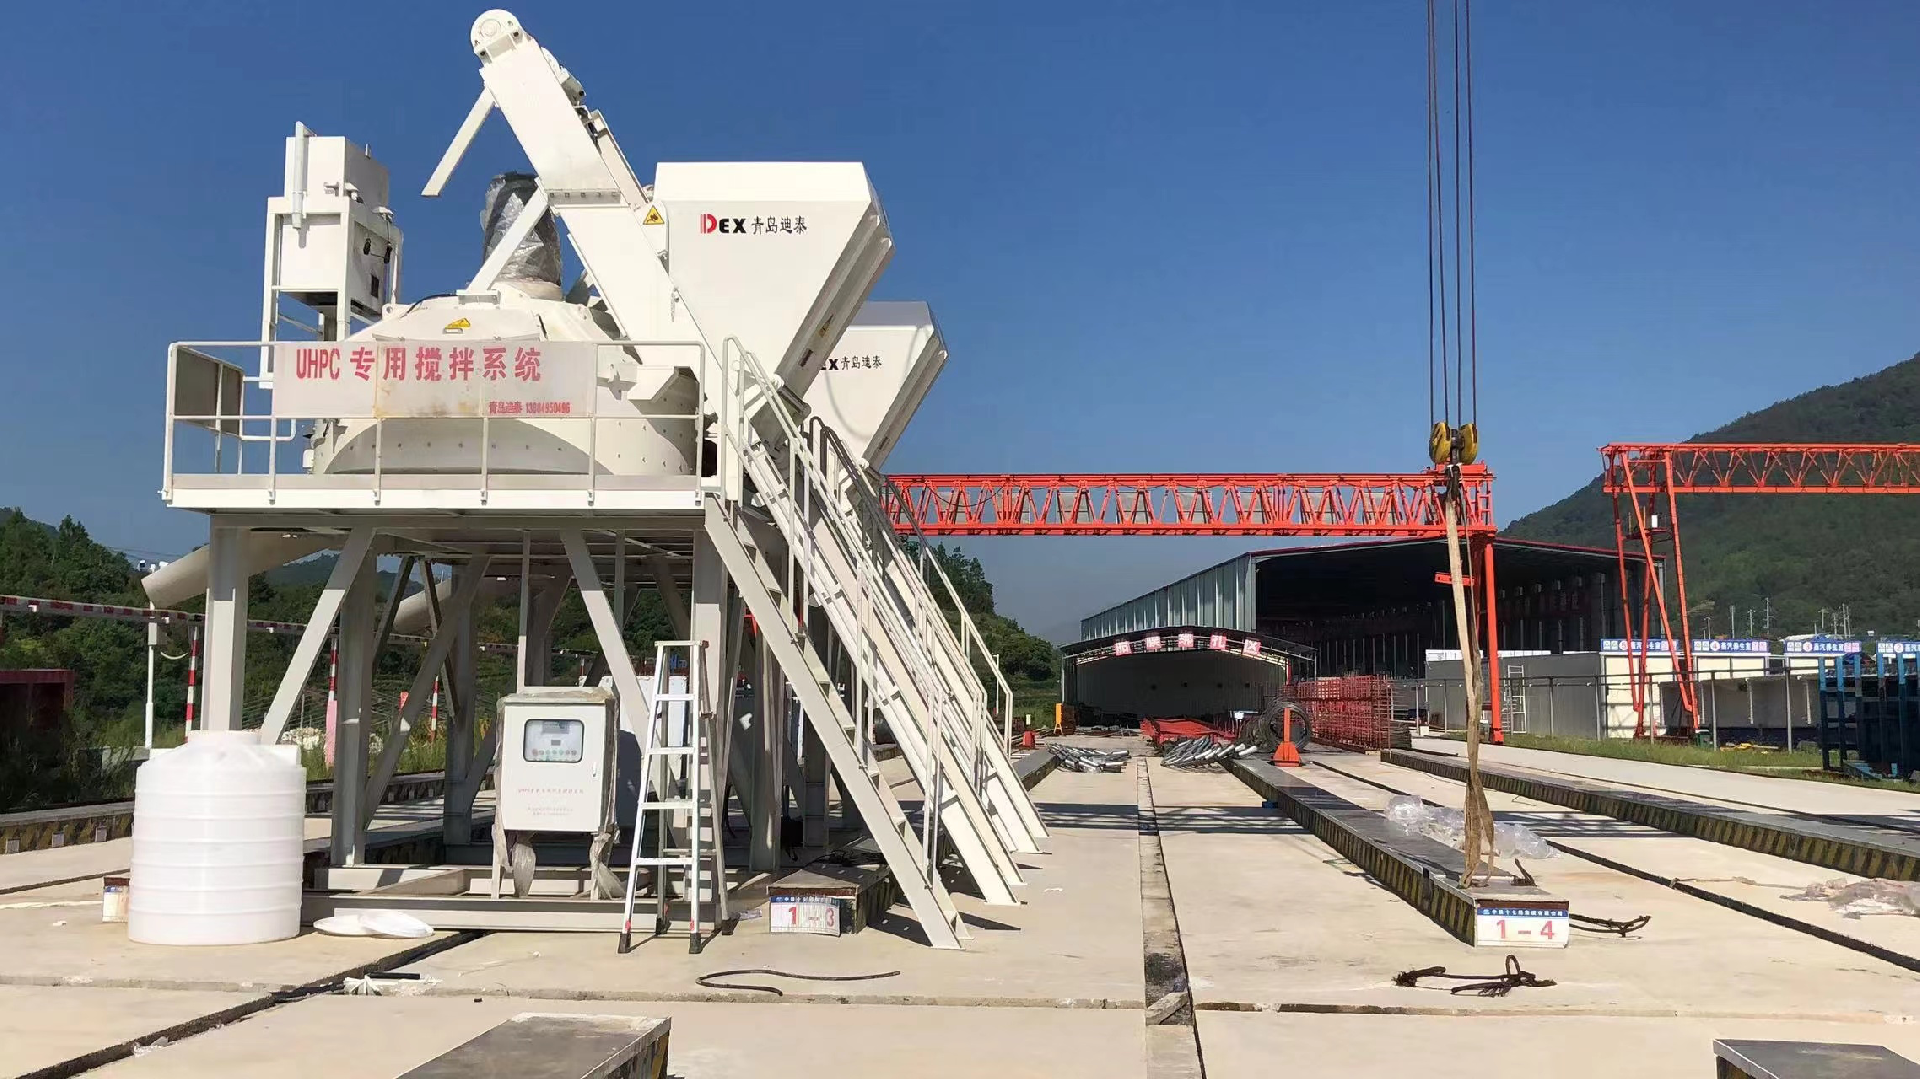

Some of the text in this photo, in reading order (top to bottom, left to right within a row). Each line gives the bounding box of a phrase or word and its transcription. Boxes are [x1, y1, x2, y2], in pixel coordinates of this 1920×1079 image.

[700, 213, 807, 235] DEX 青岛迪泰
[296, 346, 541, 382] UHPC 专用搅拌系统
